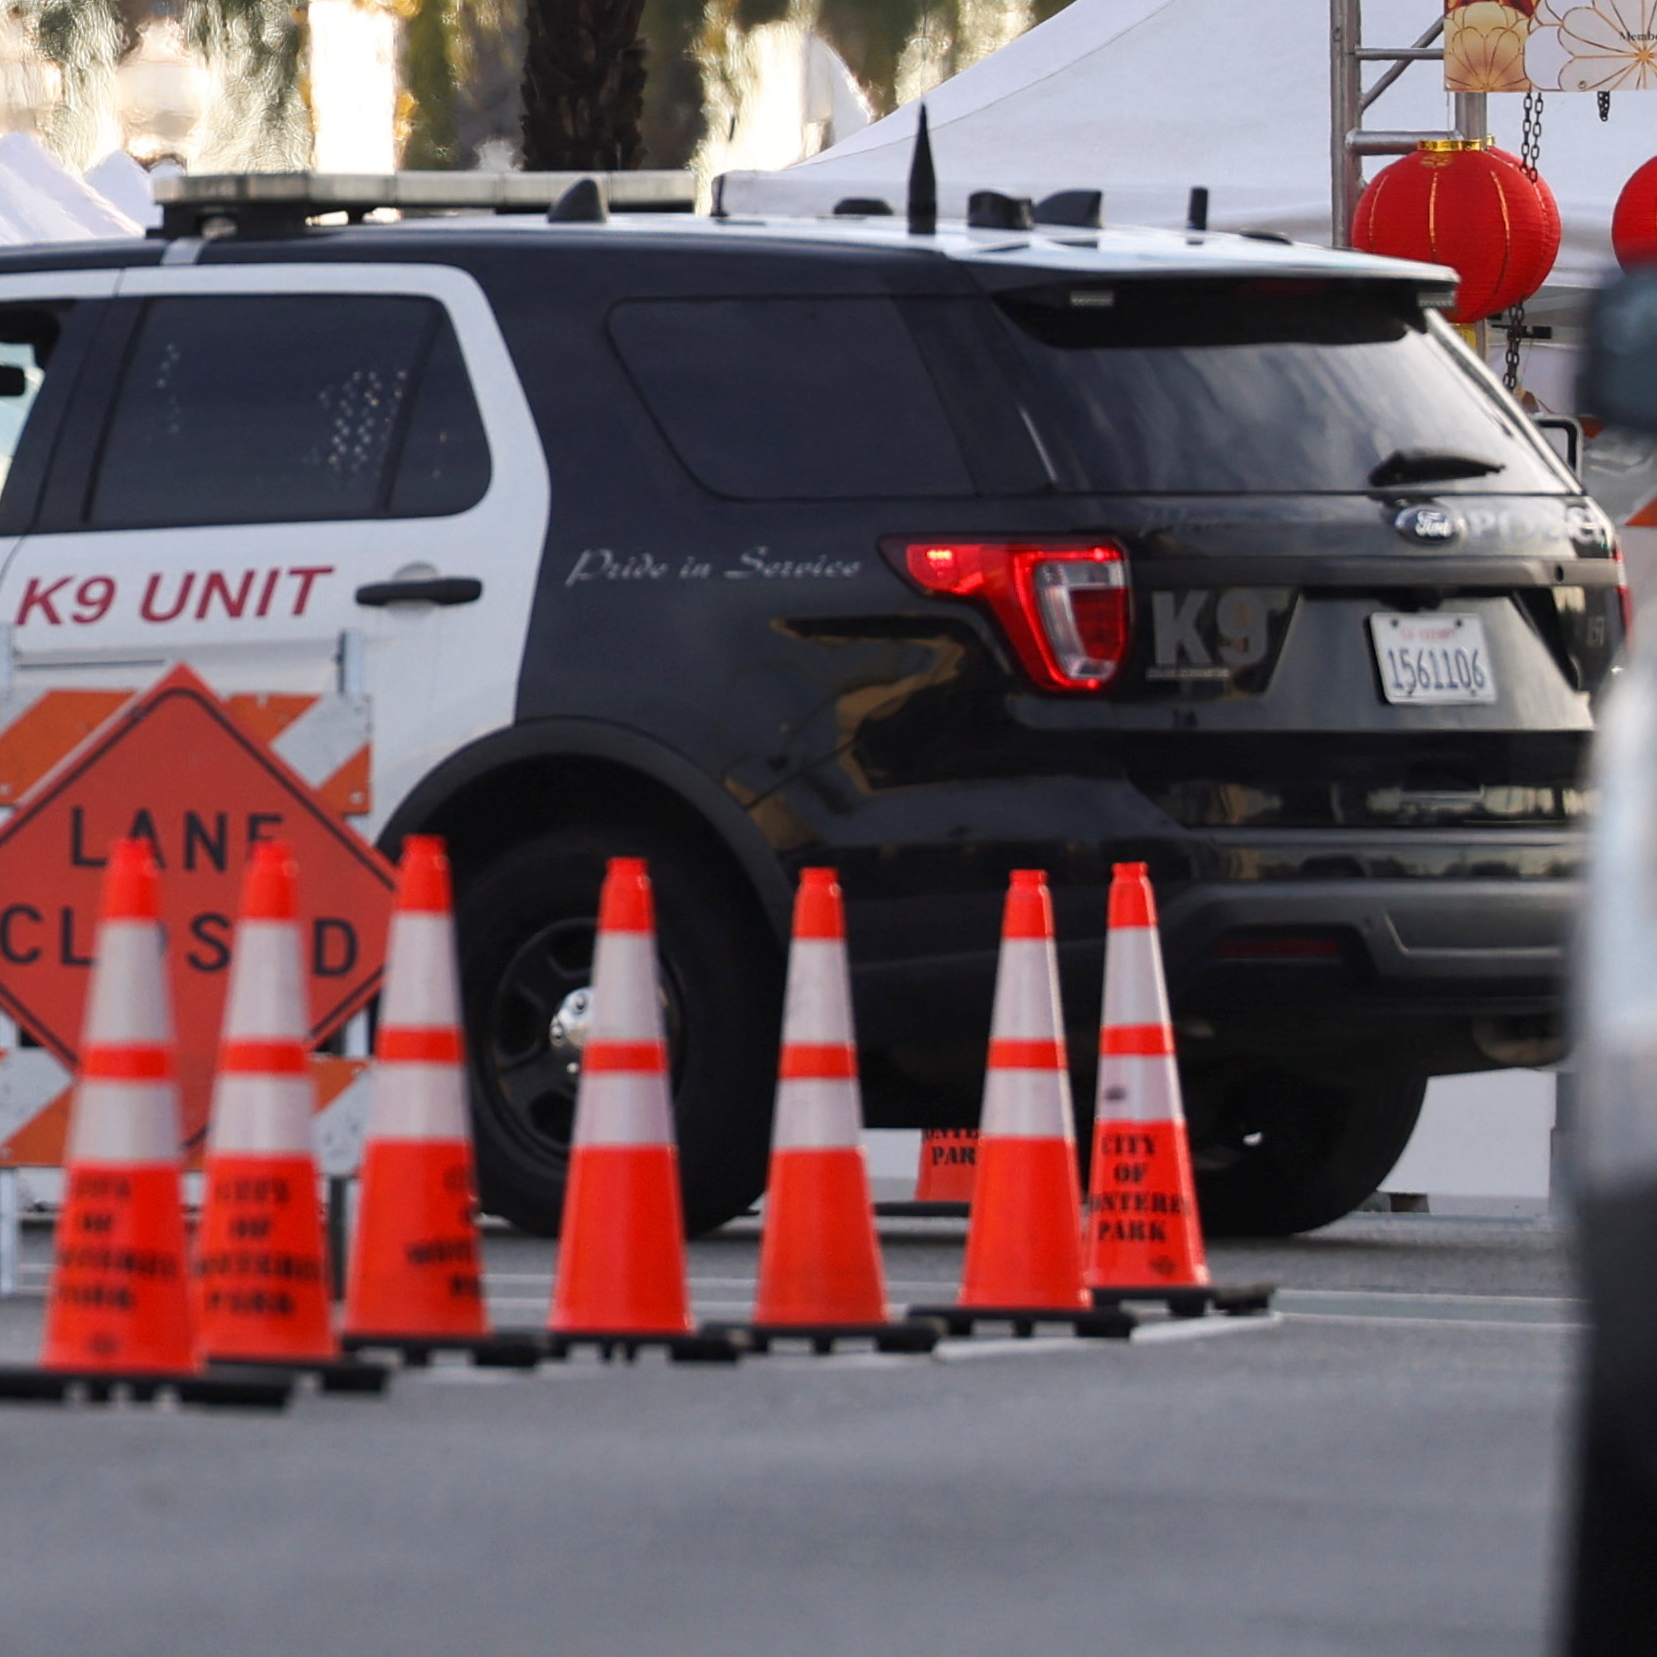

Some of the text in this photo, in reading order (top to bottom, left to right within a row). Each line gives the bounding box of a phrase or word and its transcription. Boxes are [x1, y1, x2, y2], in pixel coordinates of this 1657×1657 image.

[1415, 510, 1453, 538] Ford
[565, 545, 862, 588] Pride in Service
[14, 565, 335, 627] K9 UNIT
[1152, 589, 1269, 668] K9
[1387, 647, 1486, 690] 1561106
[932, 1146, 978, 1167] PAR
[1101, 1133, 1156, 1156] CITY
[1087, 1192, 1189, 1215] ONTERE
[1097, 1220, 1168, 1242] PARK
